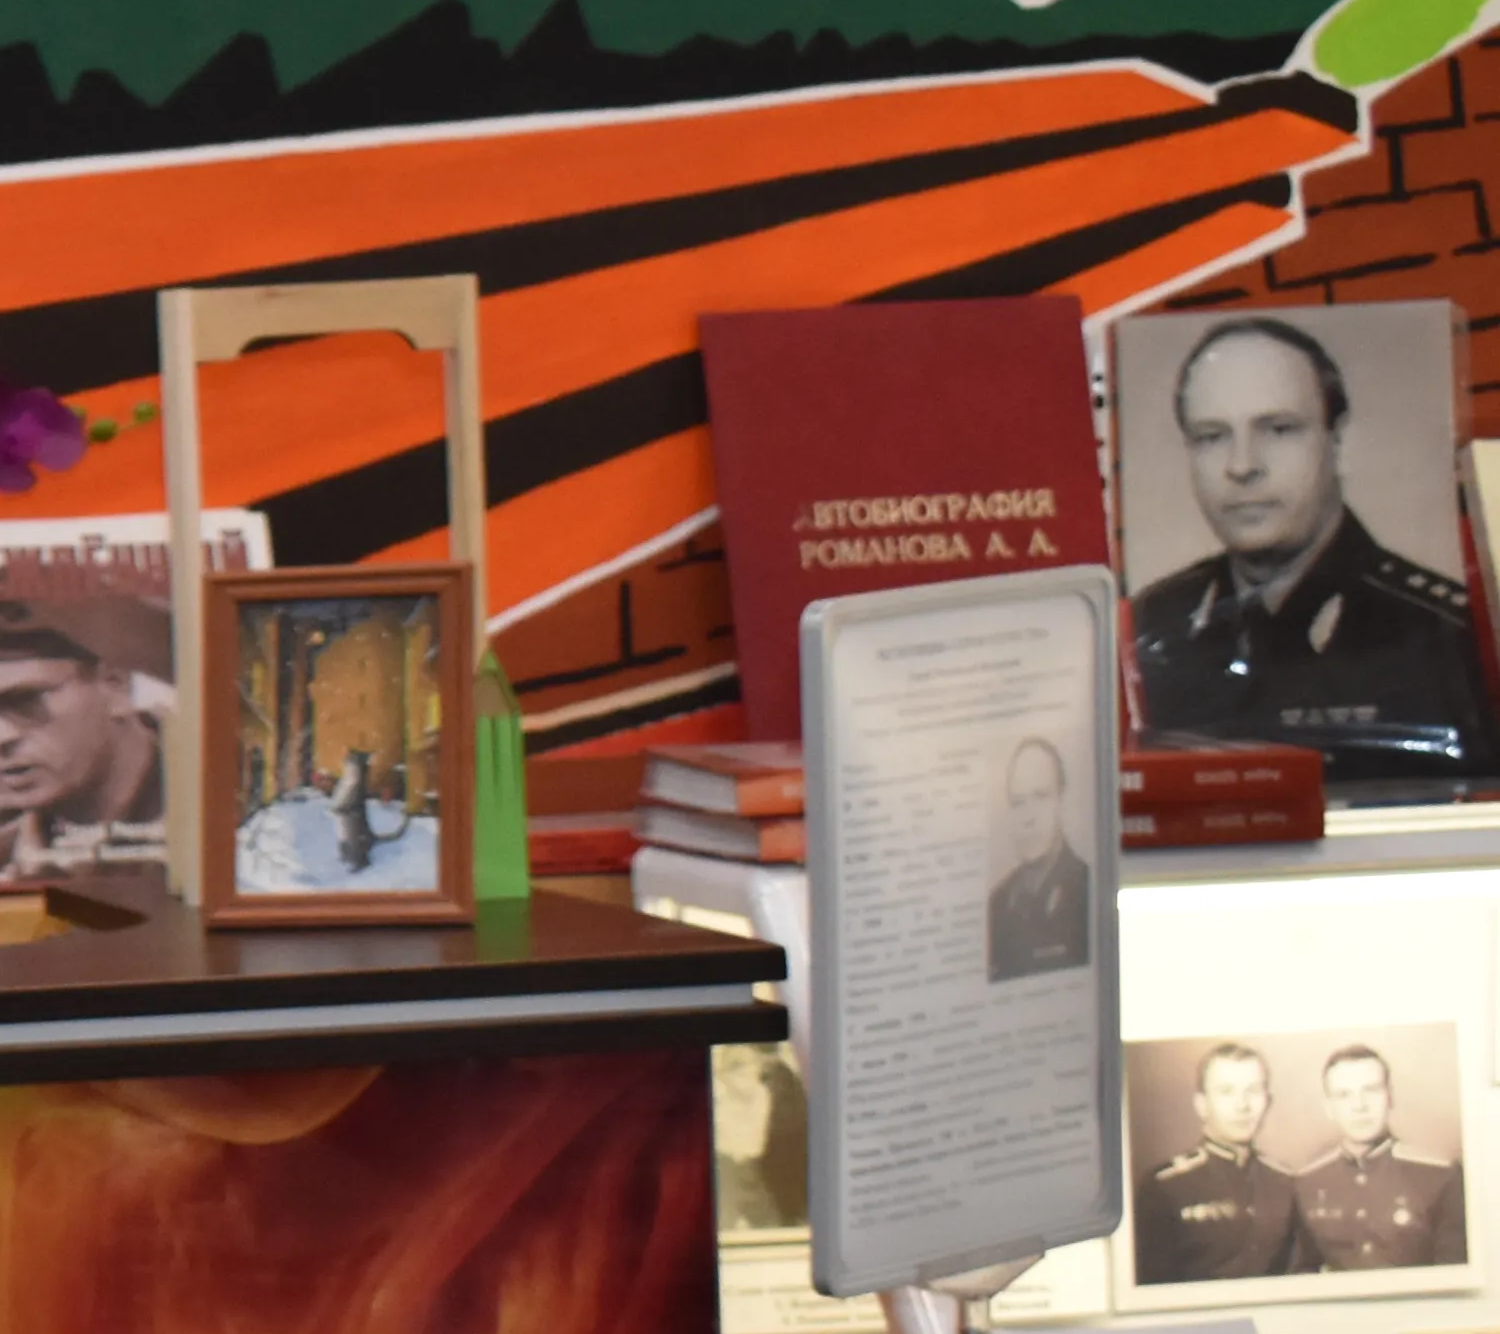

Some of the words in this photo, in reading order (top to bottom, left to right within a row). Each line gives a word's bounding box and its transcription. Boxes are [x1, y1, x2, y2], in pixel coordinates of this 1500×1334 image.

[793, 488, 1056, 531] АВТОБИОГРАФИЯ
[799, 531, 972, 570] РОМАНОВА
[985, 531, 1015, 558] А.
[1028, 527, 1059, 557] А.
